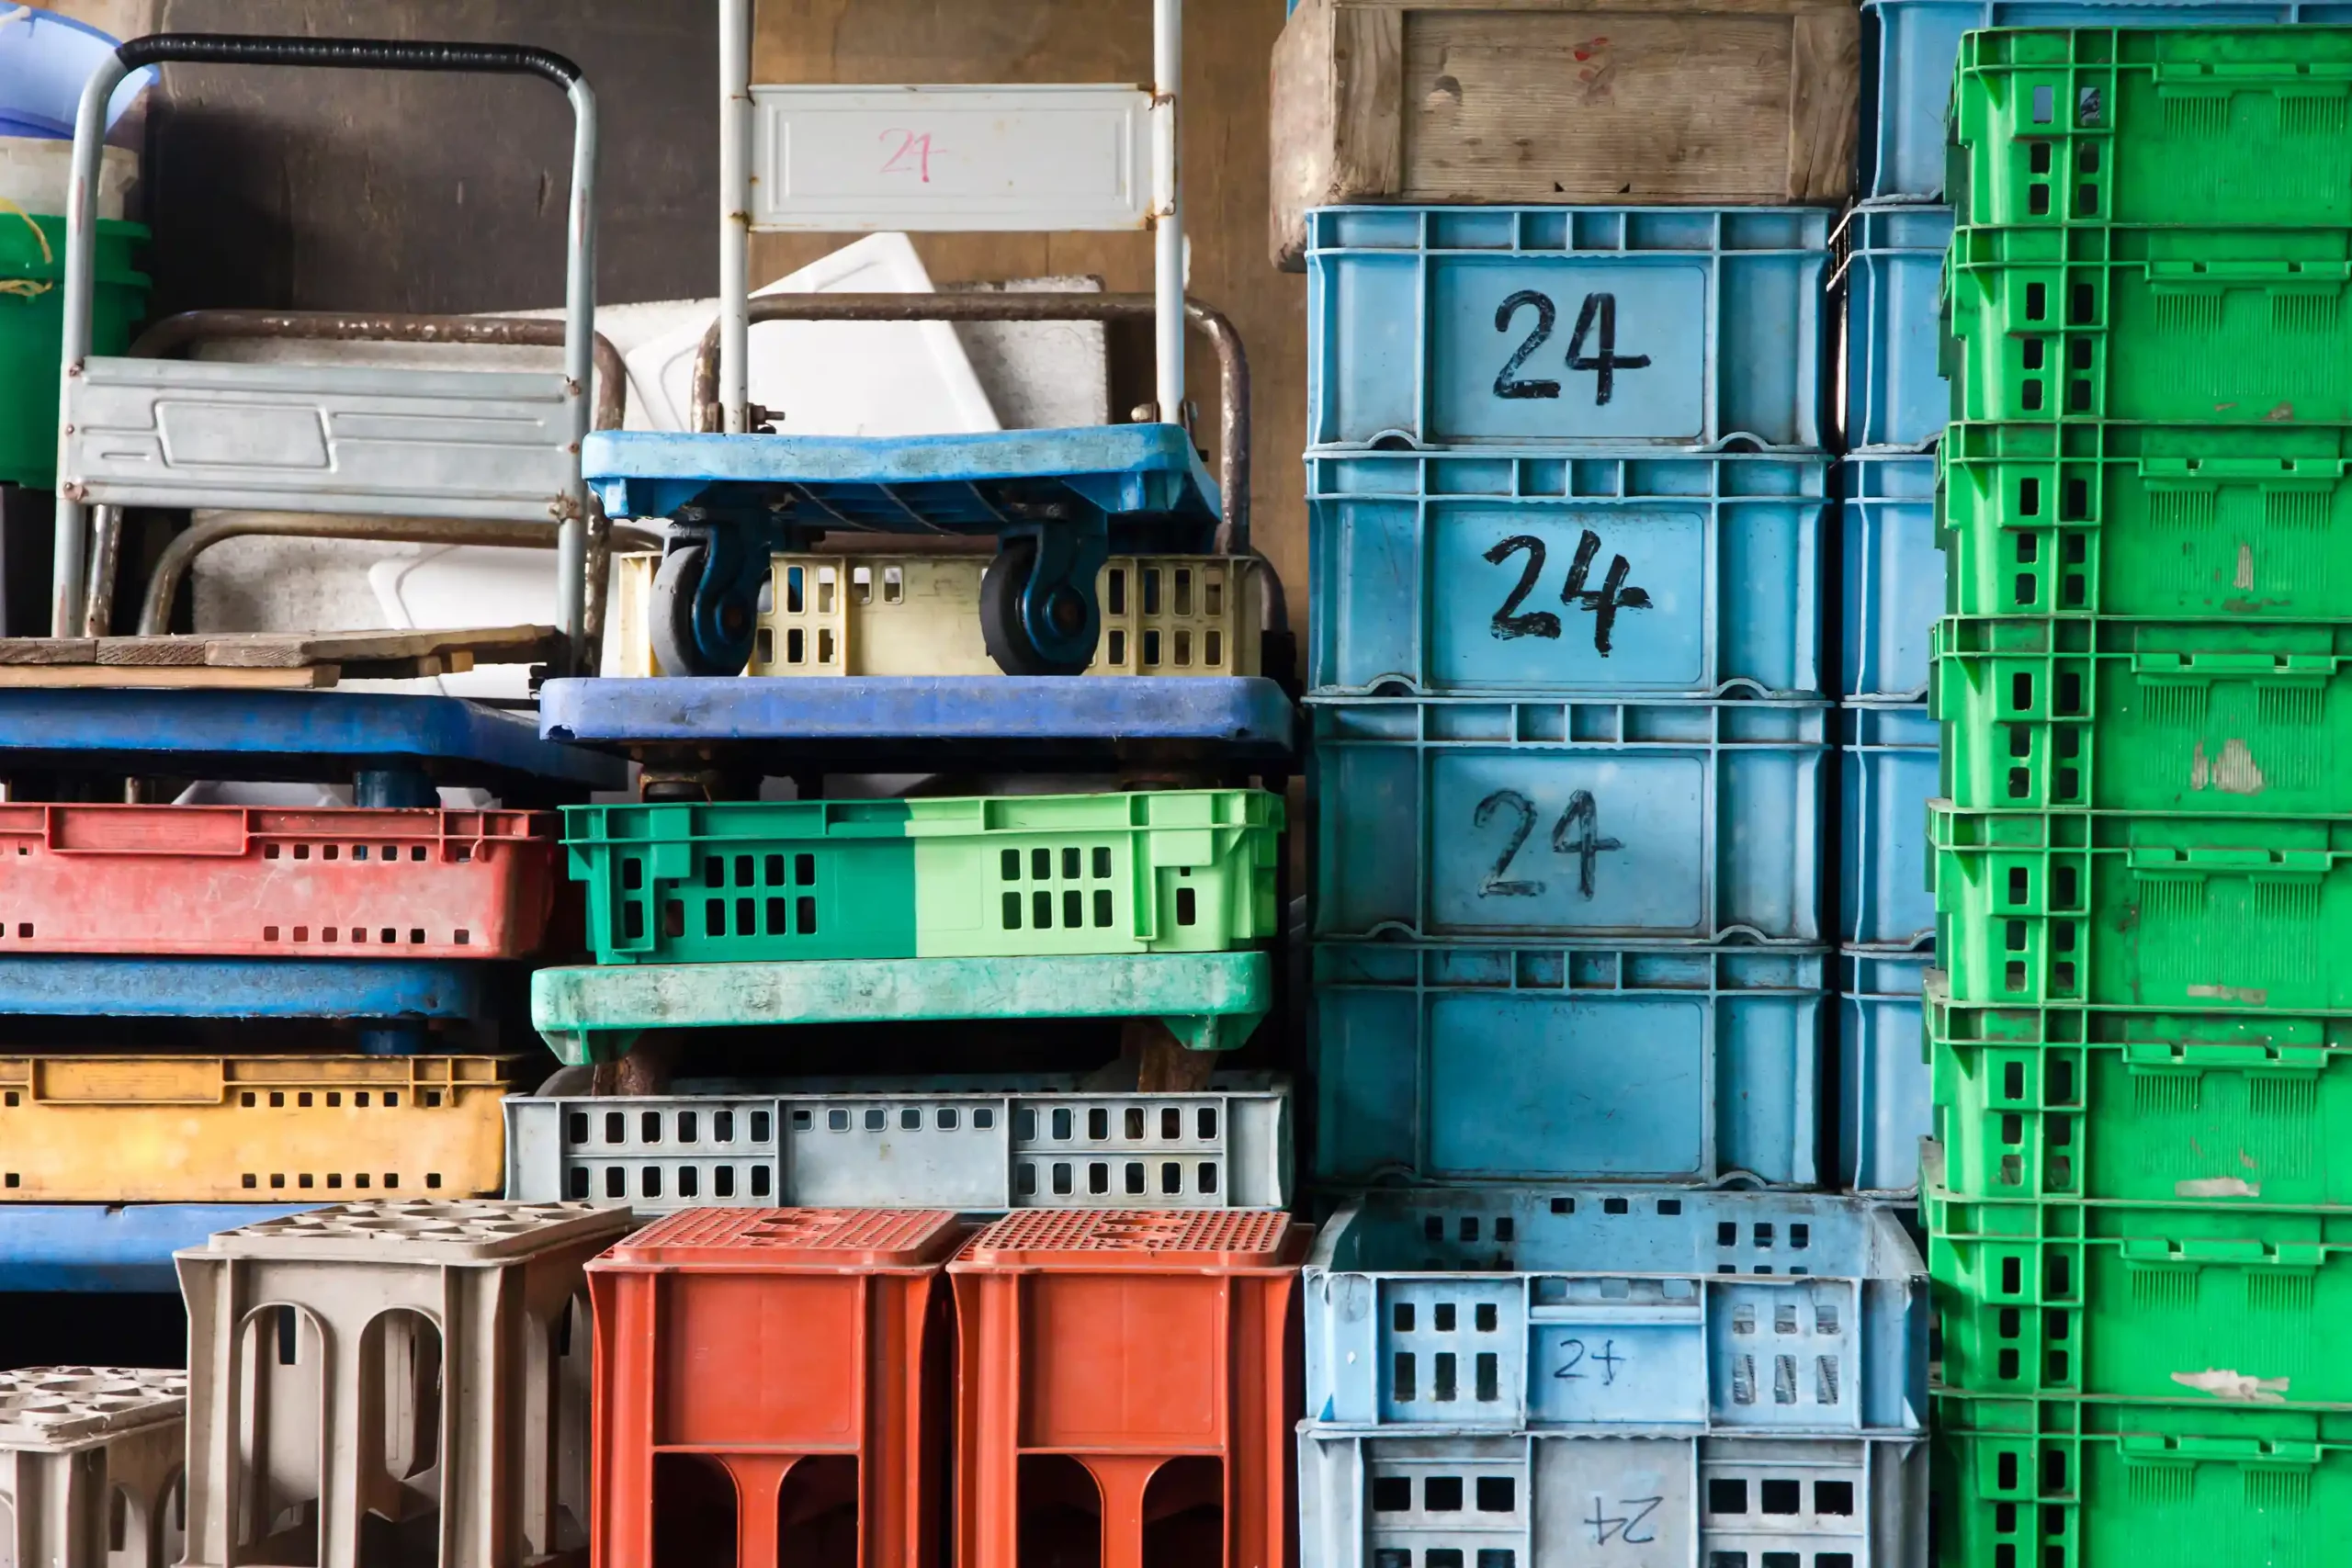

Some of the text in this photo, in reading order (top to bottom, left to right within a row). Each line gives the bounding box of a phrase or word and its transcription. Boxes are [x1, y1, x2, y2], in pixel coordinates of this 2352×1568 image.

[1493, 290, 1651, 405] 24
[1482, 529, 1653, 658] 24
[1474, 791, 1626, 901] 24
